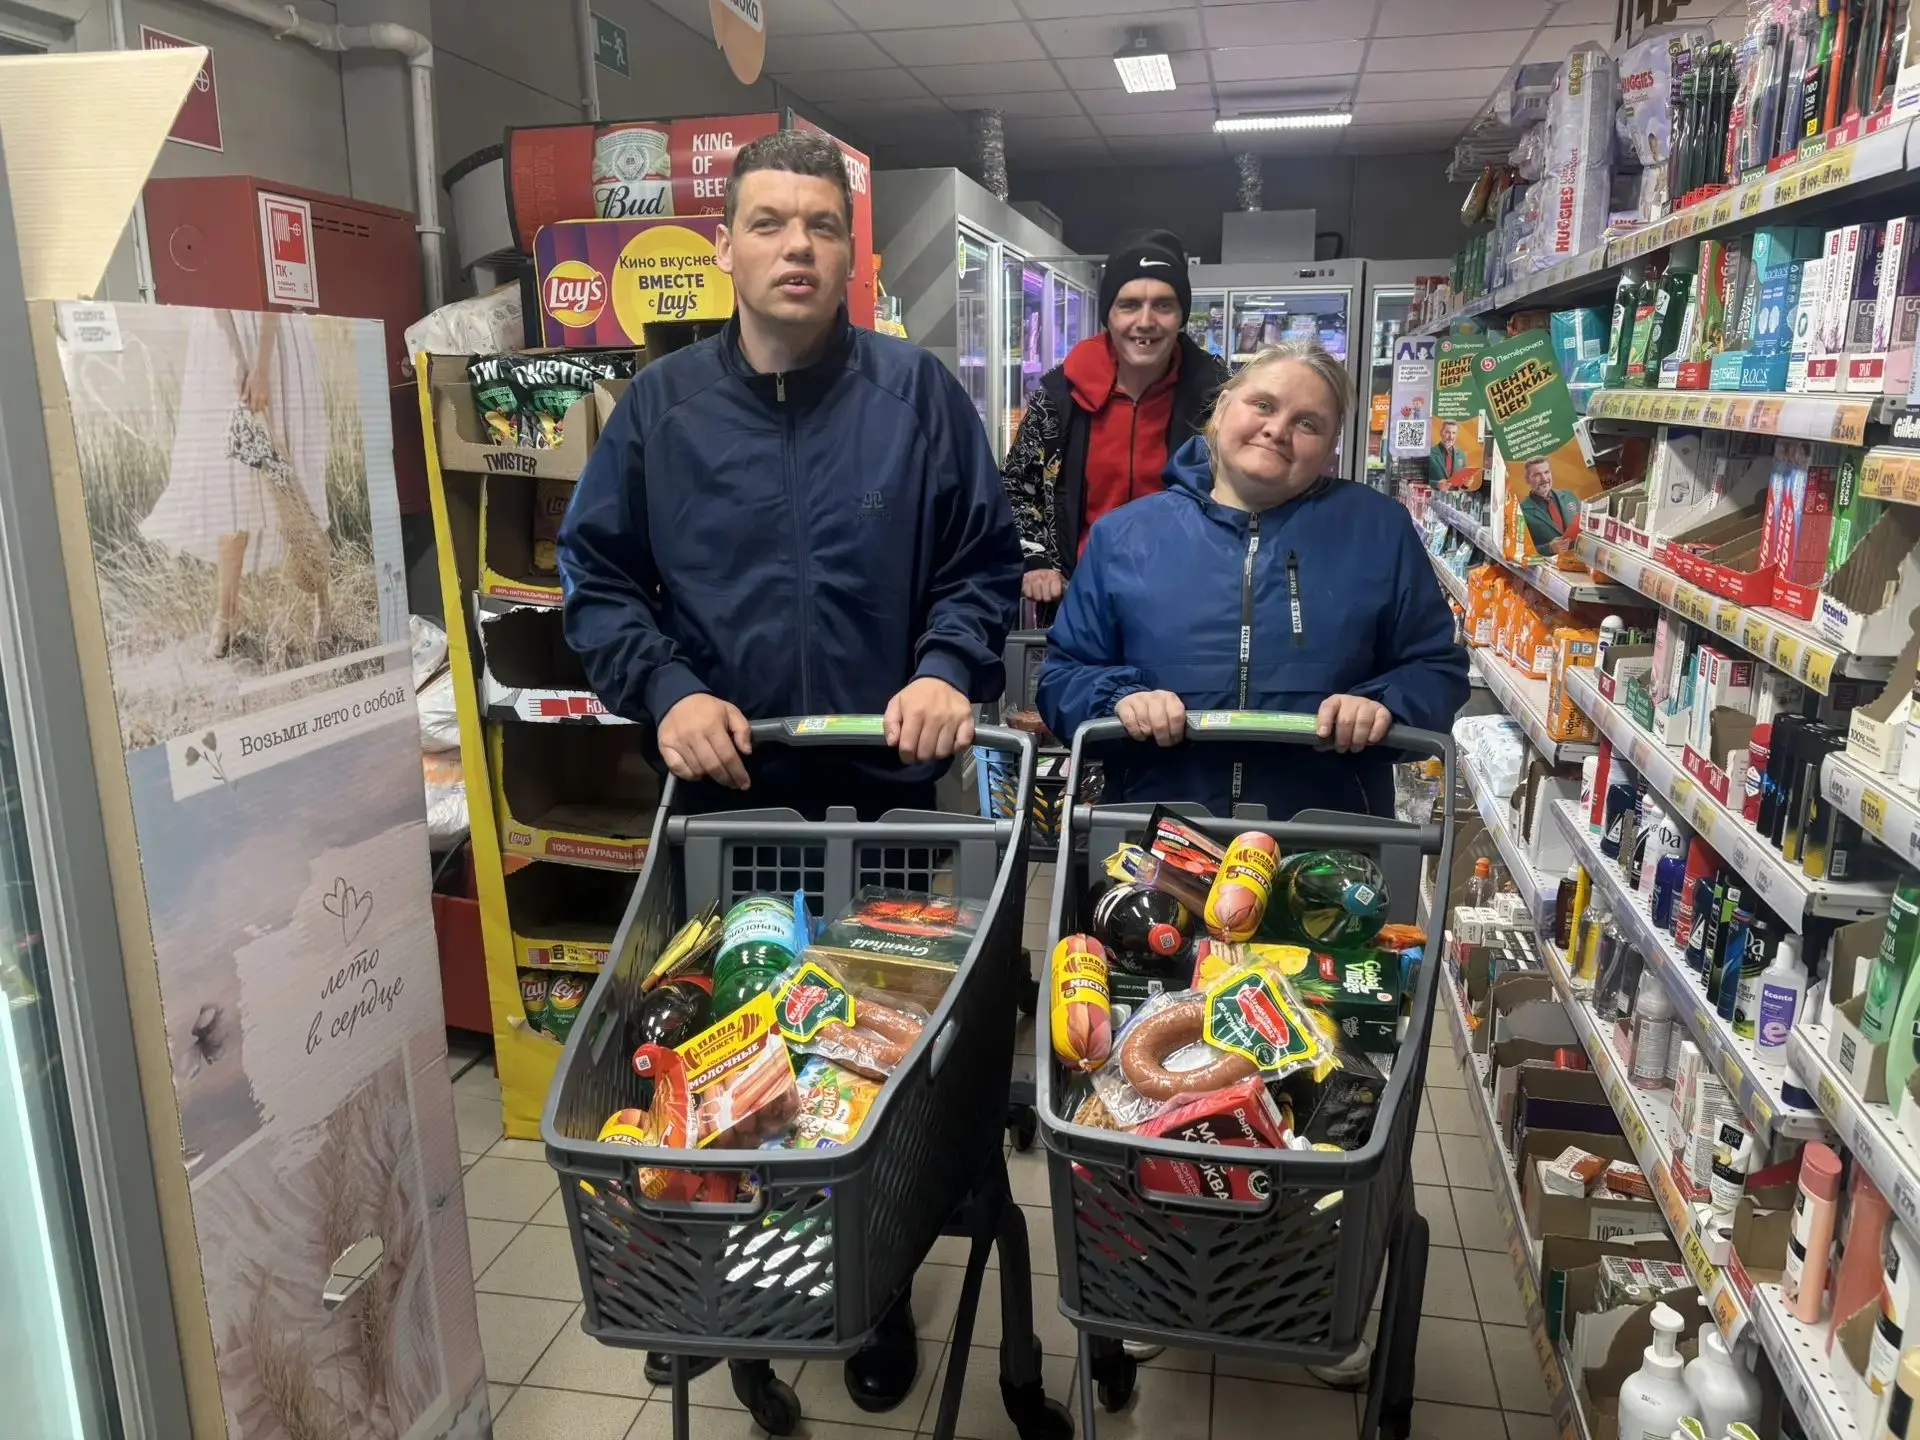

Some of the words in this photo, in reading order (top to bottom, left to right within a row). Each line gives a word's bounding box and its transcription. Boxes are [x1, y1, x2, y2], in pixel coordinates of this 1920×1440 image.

[692, 132, 733, 152] KING
[692, 156, 713, 175] OF
[693, 177, 727, 198] BEE
[595, 186, 665, 219] Bud
[1556, 187, 1575, 253] HUGGIES
[620, 255, 656, 269] Кино
[660, 255, 718, 271] вкуснее
[550, 277, 602, 313] Lay's
[638, 273, 705, 290] ВМЕСТЕ
[657, 290, 697, 319] Lay's
[1496, 340, 1544, 364] Пятёрочка
[512, 360, 594, 389] TWISTER
[1440, 367, 1472, 379] НИЗК
[1440, 376, 1461, 387] ЦЕН
[1490, 362, 1536, 397] ЦЕНТР
[1493, 366, 1553, 409] НИЗКИХ
[1497, 395, 1528, 420] ЦЕН
[483, 452, 538, 476] TWISTER
[1822, 599, 1849, 627] Econta
[240, 717, 308, 757] Возьми
[312, 709, 349, 735] лето
[352, 705, 361, 720] с
[364, 687, 407, 716] собой
[552, 842, 574, 854] 100%
[577, 846, 645, 860] НАТУРАЛЬНЫЙ
[321, 947, 380, 999] лето
[1345, 961, 1369, 995] Village
[1363, 959, 1383, 995] Global
[330, 976, 405, 1038] сердце
[1763, 989, 1793, 1002] Econta
[697, 1021, 737, 1048] ПАПА
[703, 1035, 735, 1058] МОЖЕТ
[688, 1042, 760, 1091] МОЛОЧНЫЕ
[1233, 1107, 1261, 1148] Выруч
